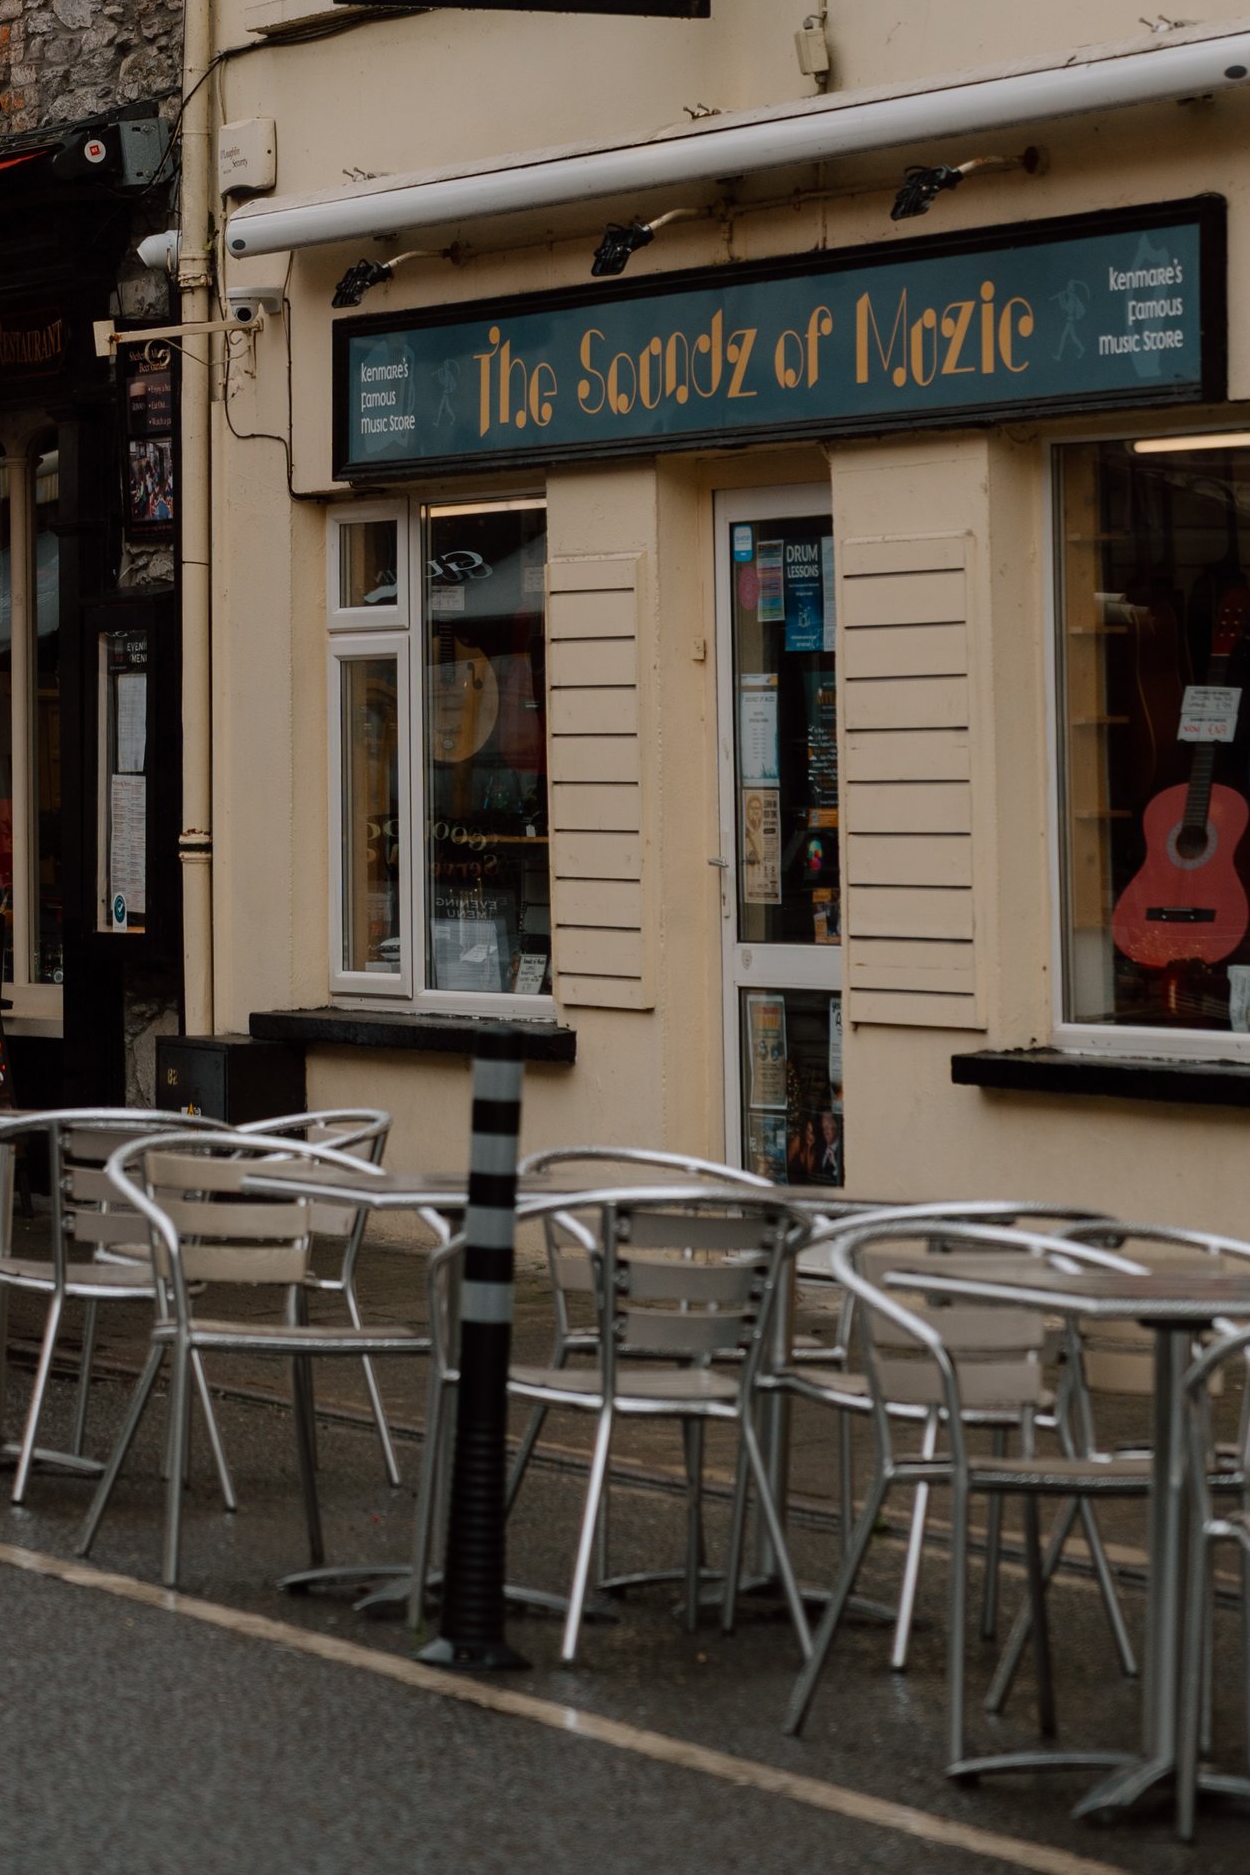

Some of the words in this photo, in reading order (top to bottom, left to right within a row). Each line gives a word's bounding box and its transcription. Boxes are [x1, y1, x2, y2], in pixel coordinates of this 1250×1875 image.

[578, 309, 758, 414] Soundz
[774, 306, 833, 389] of
[856, 280, 1035, 388] Muzic
[786, 544, 818, 563] DRUM
[787, 565, 819, 578] LESSONS
